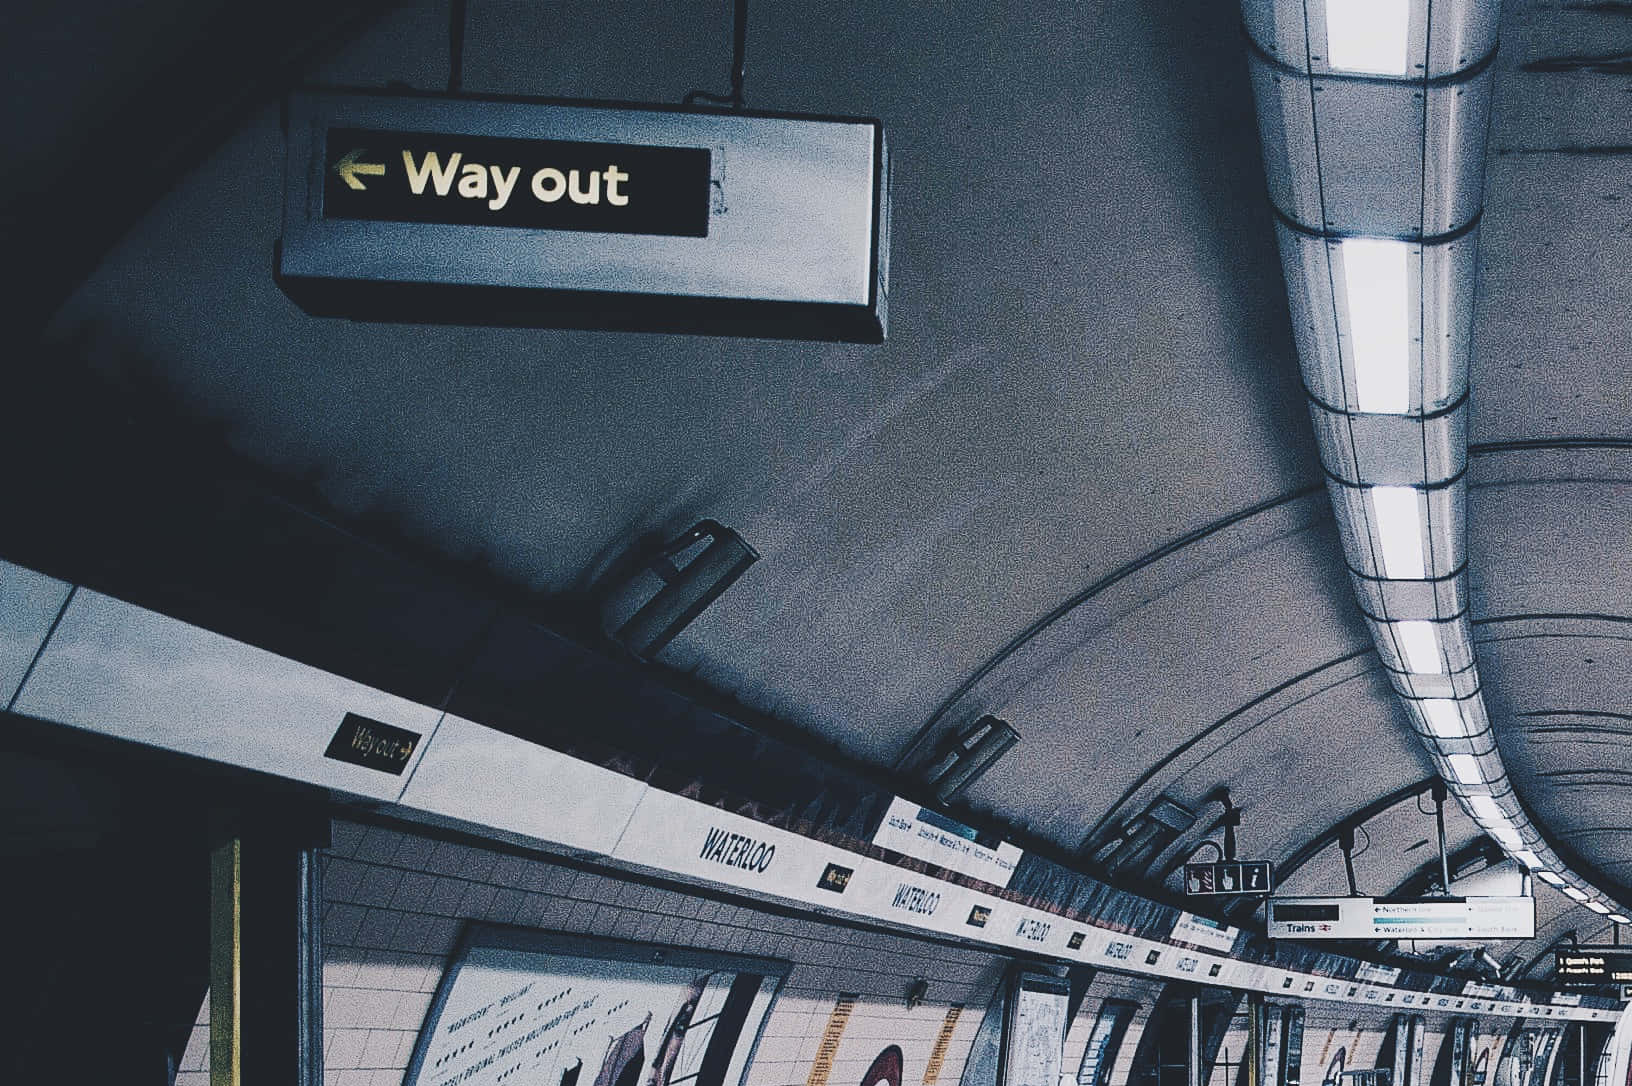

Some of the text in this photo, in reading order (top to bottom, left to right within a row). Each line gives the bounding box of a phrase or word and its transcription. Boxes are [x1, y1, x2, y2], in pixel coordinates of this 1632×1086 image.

[401, 149, 630, 211] Way out
[351, 725, 400, 759] Way out
[699, 826, 776, 874] WATERLOO
[892, 883, 941, 916] WATERLOO
[1286, 923, 1316, 933] Trains
